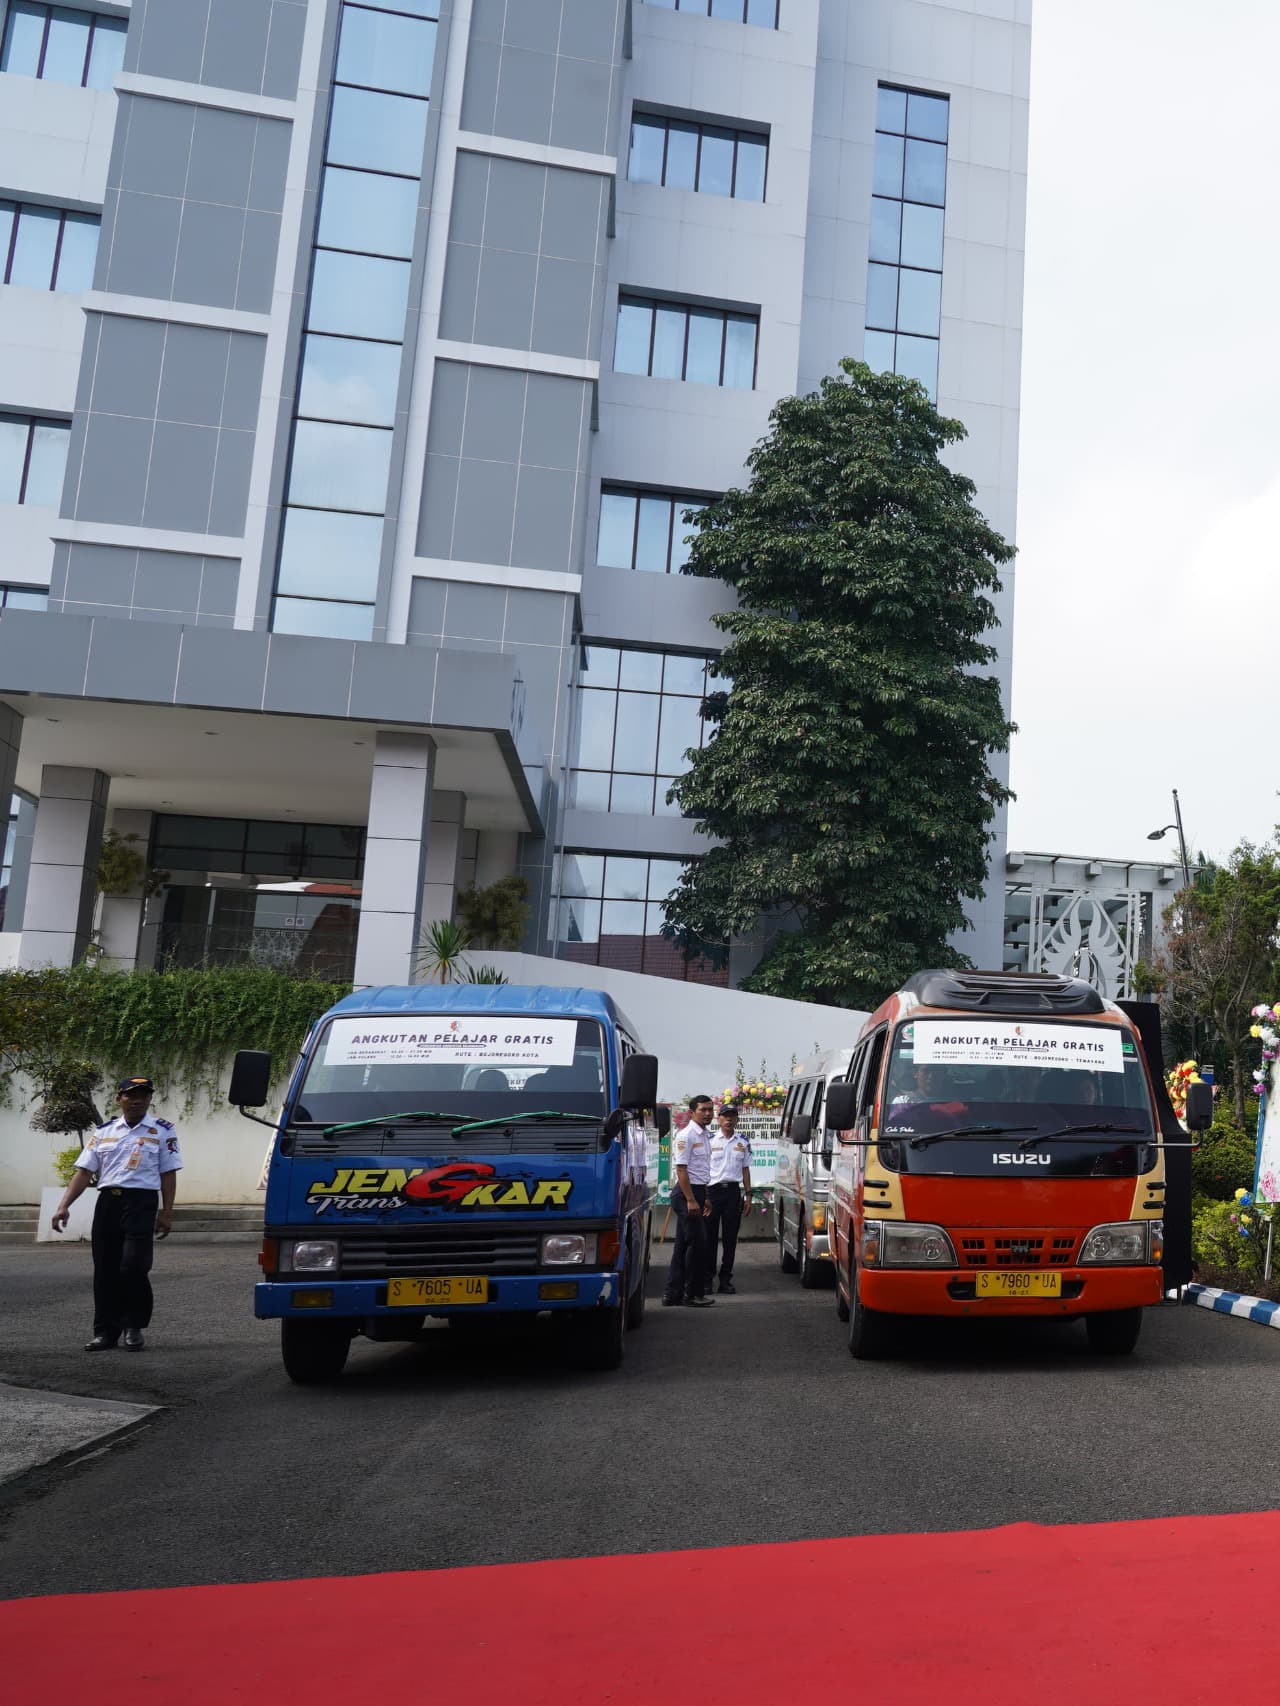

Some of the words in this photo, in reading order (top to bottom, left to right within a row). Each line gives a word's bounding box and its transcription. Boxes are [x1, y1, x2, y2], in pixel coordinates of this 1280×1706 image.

[352, 1034, 428, 1044] ANGKUTAN
[434, 1034, 498, 1043] PELAJAR
[504, 1035, 553, 1045] GRATIS
[933, 1036, 998, 1046] ANGKUTAN
[1003, 1039, 1057, 1048] PELAJAR
[1063, 1041, 1105, 1052] GRATIS
[992, 1153, 1051, 1165] ISUZU
[306, 1194, 408, 1214] Trans
[393, 1281, 402, 1296] S
[417, 1280, 452, 1295] 7605
[466, 1279, 483, 1294] UA
[981, 1274, 989, 1288] S
[1001, 1274, 1031, 1288] 7960
[1042, 1274, 1057, 1288] UA
